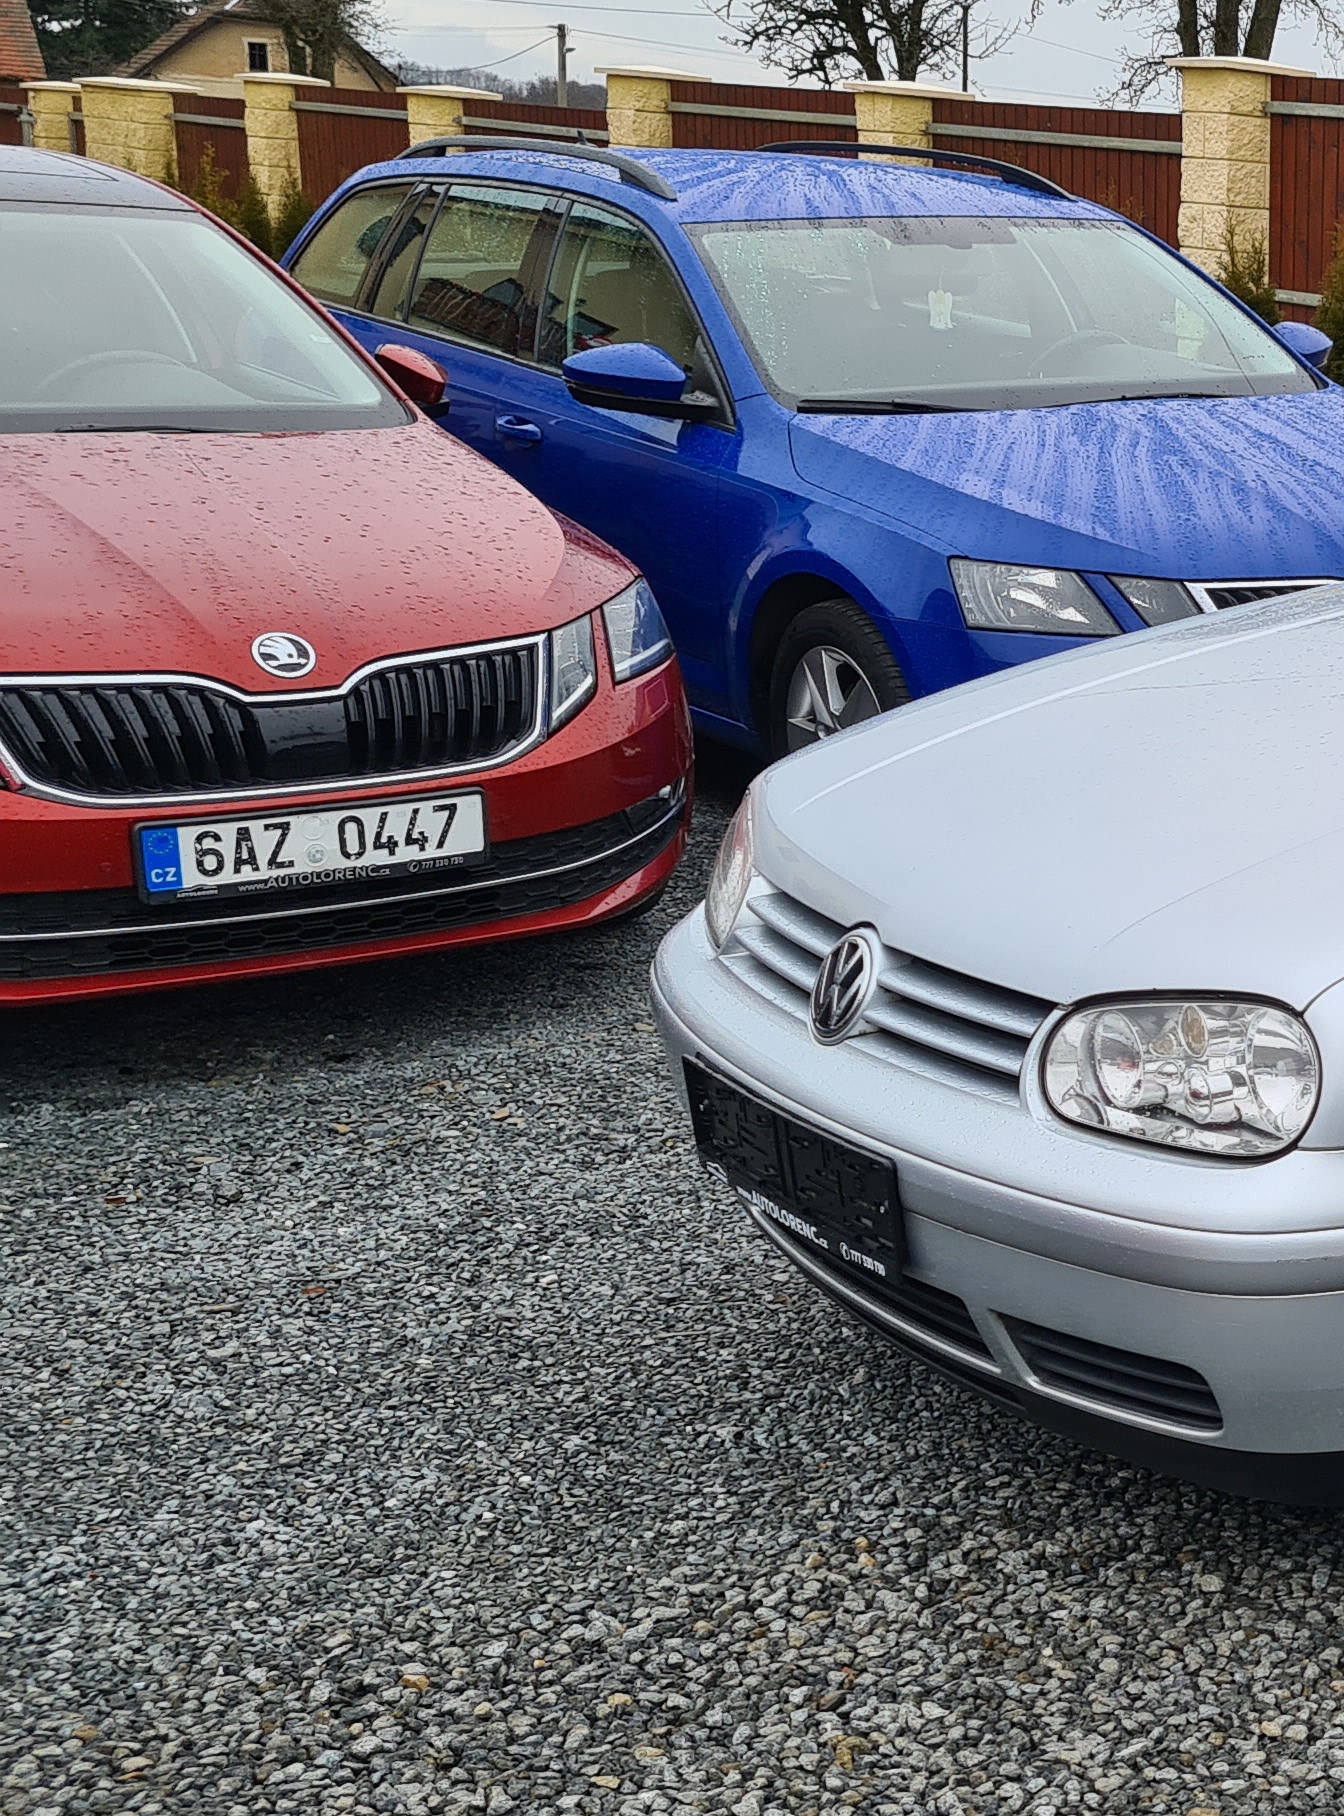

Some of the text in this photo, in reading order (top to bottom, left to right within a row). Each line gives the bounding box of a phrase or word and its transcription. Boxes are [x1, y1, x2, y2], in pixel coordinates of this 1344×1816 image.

[193, 802, 459, 878] 6AZ 0447
[151, 867, 178, 884] CZ
